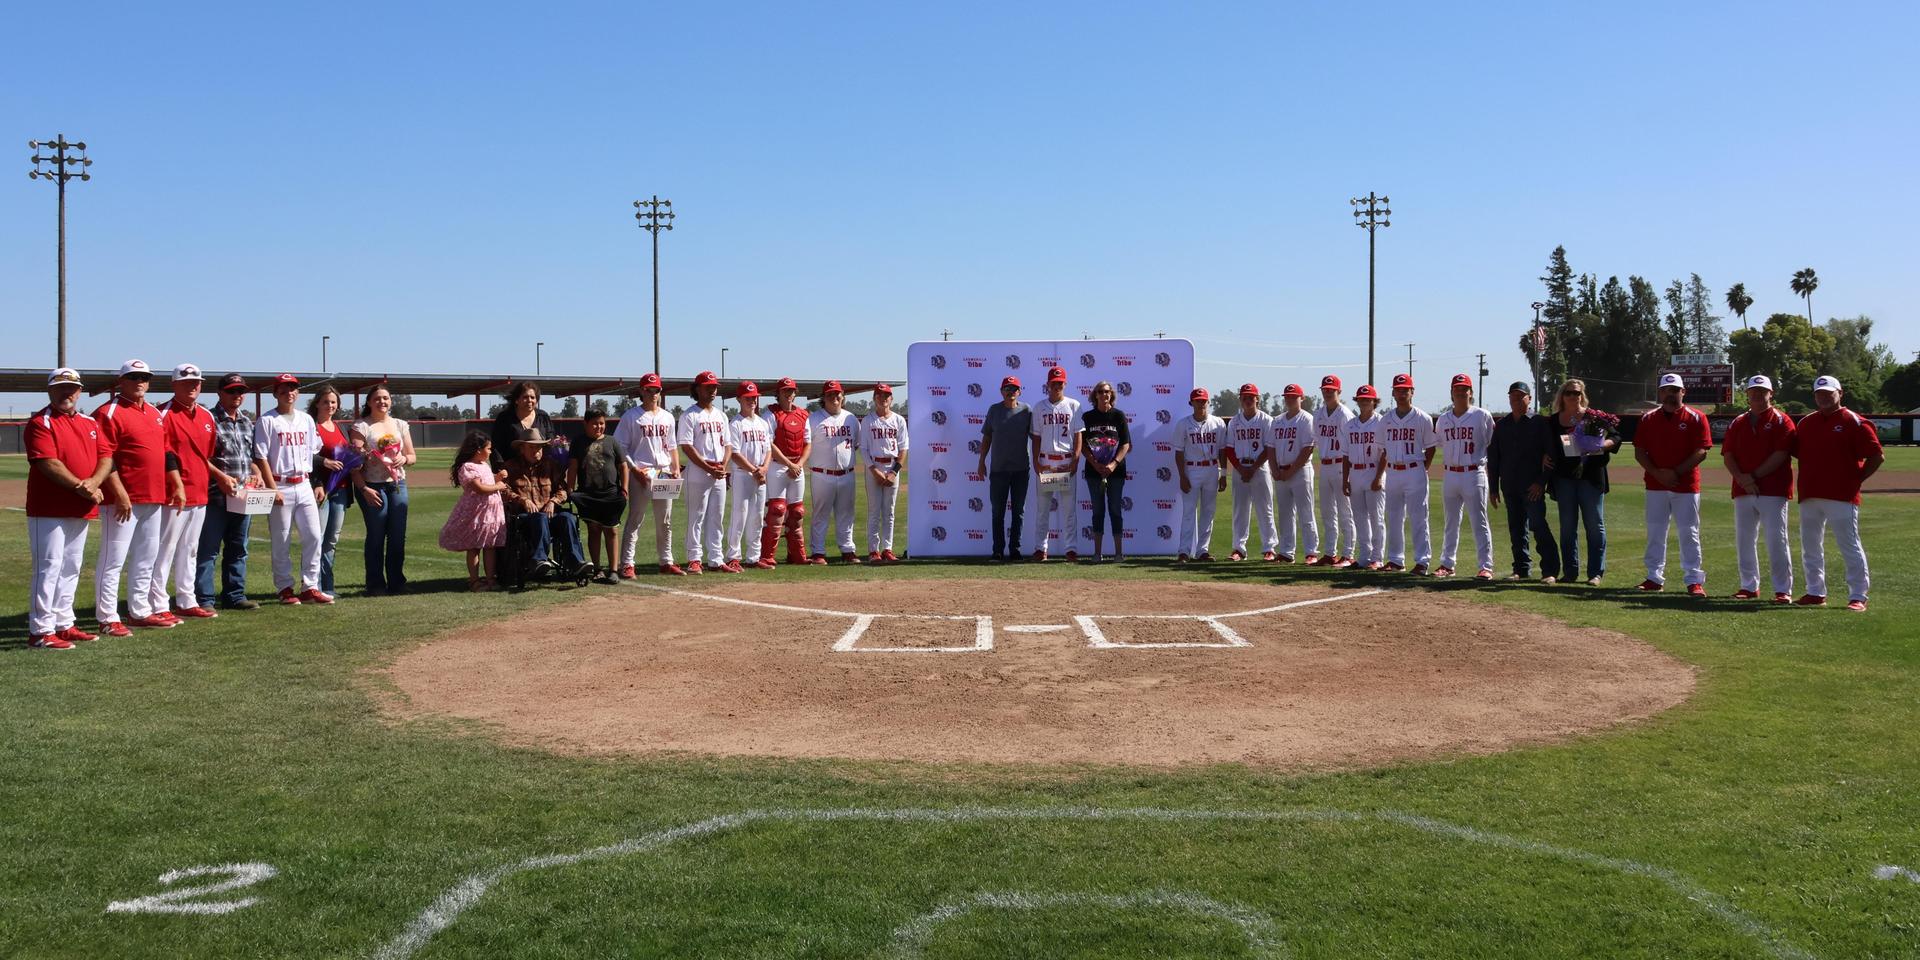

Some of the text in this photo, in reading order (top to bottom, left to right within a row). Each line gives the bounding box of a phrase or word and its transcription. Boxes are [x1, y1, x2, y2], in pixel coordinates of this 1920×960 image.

[131, 360, 145, 369] C
[1054, 369, 1062, 377] C
[1396, 375, 1406, 383] C
[1665, 375, 1675, 383] C
[1754, 376, 1765, 384] C
[1817, 377, 1828, 386] C
[1043, 413, 1071, 426] TRIBE
[824, 425, 851, 438] TRIBE
[871, 428, 898, 440] TRIBE
[1061, 426, 1068, 437] 2
[1236, 428, 1261, 441] TRIBE
[1274, 427, 1297, 440] TRIBE
[1350, 431, 1375, 444] TRIBE
[1387, 428, 1416, 441] TRIBE
[1444, 426, 1474, 440] TRIBE
[278, 431, 307, 447] TRIB
[1189, 432, 1217, 445] TRIBE
[890, 440, 896, 452] 3
[1252, 441, 1259, 452] 9
[1288, 440, 1294, 452] 7
[1366, 445, 1372, 457] 4
[1405, 442, 1414, 455] 11
[106, 860, 279, 915] 2
